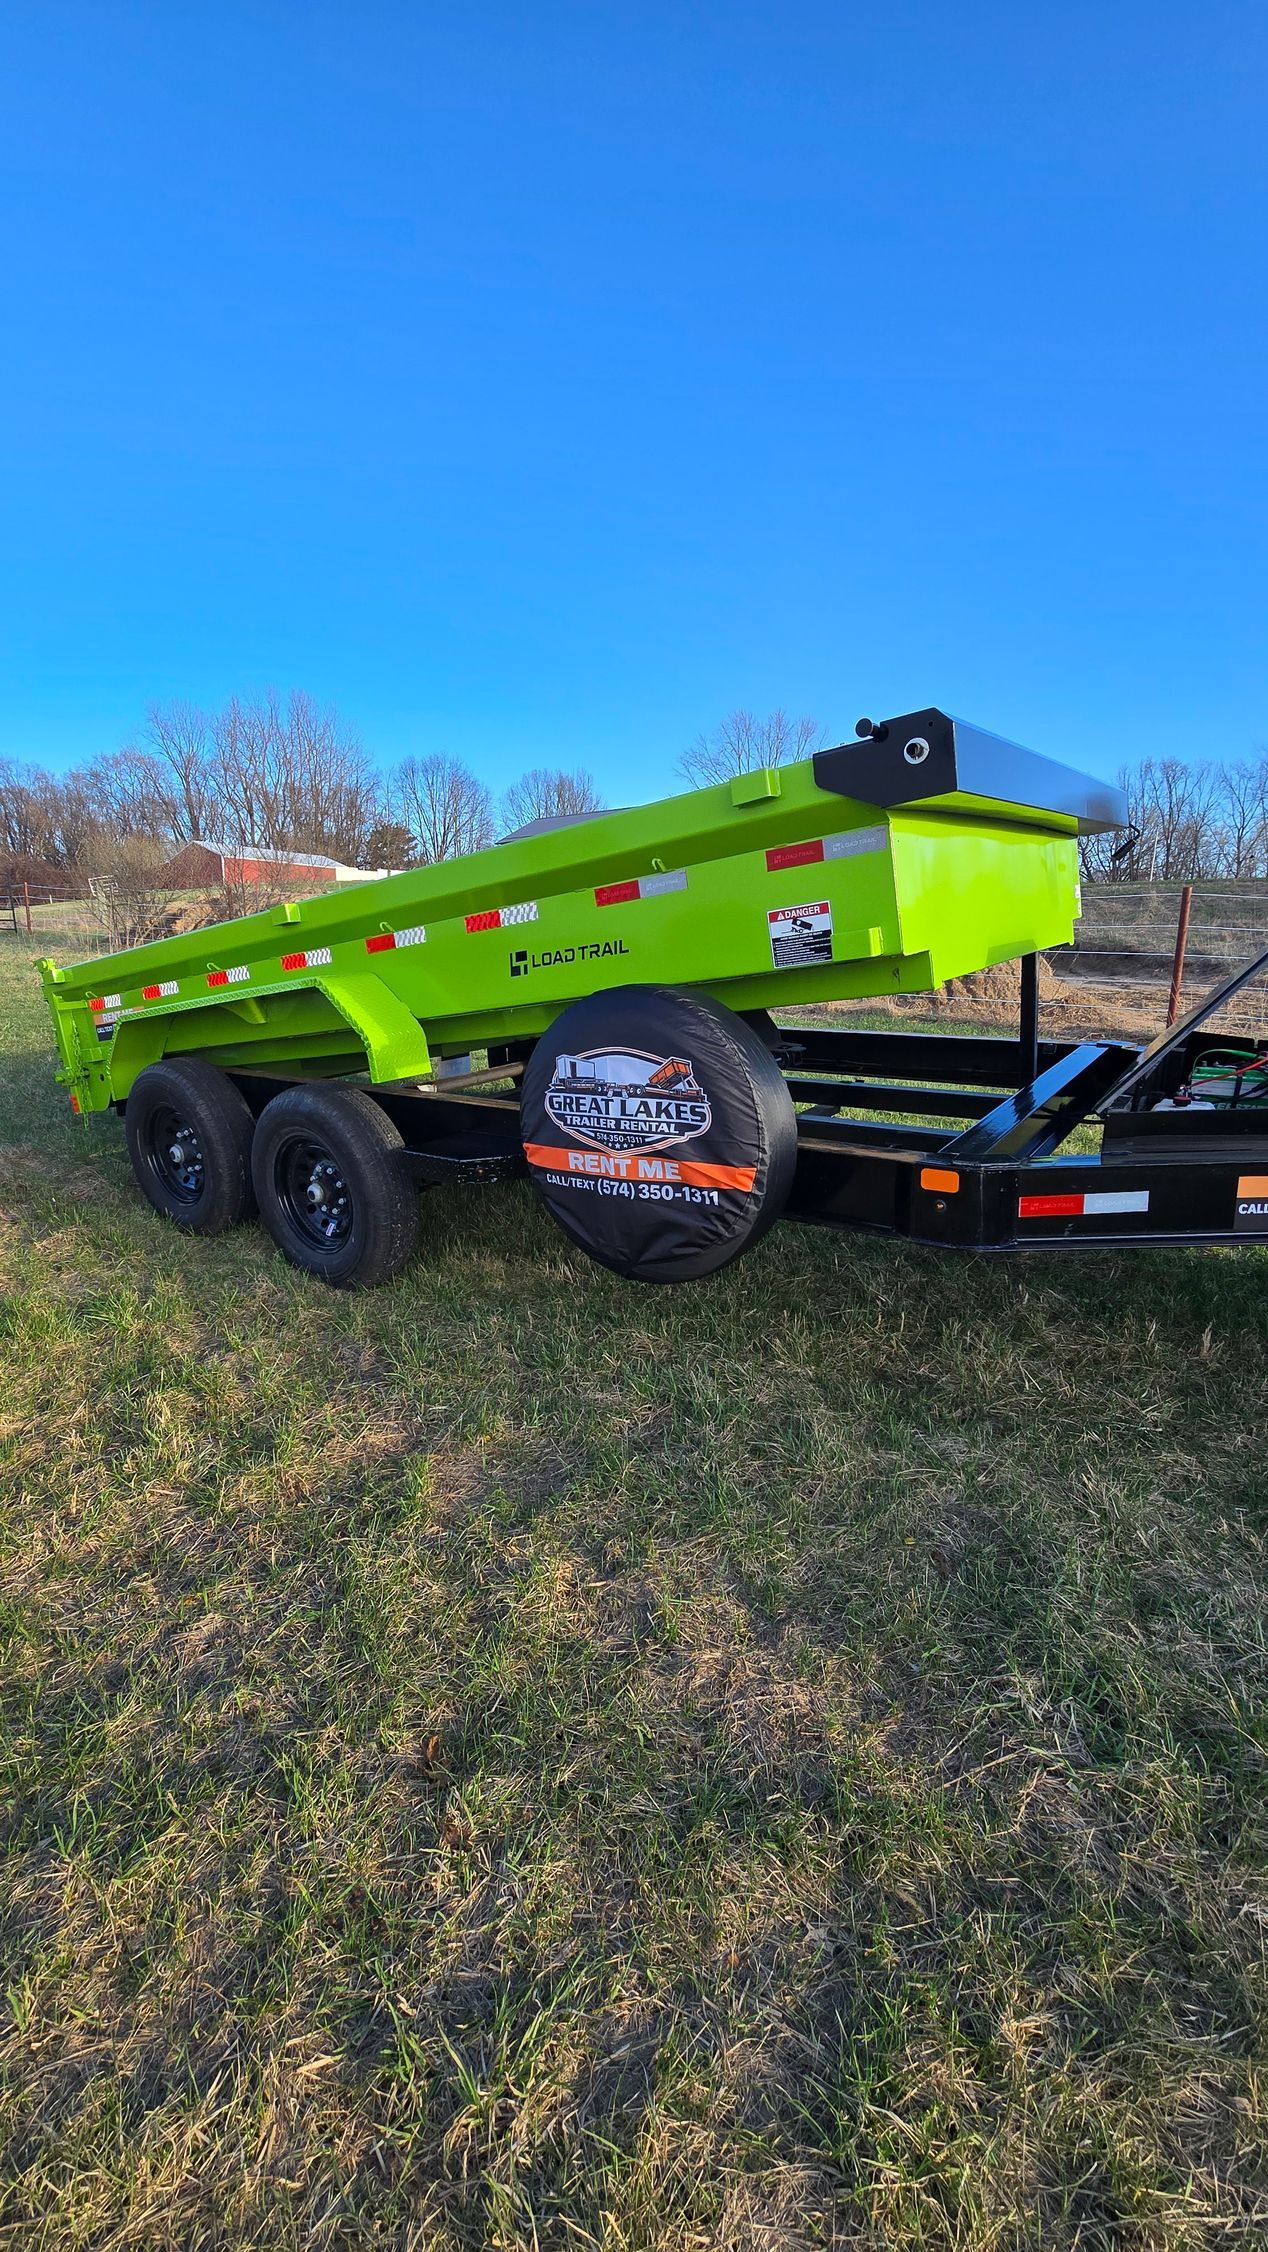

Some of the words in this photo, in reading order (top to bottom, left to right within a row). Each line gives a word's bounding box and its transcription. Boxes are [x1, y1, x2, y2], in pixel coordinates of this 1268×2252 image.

[785, 906, 820, 918] DANGER
[532, 948, 575, 968] LOAD
[578, 940, 629, 960] TRAIL
[549, 1094, 614, 1116] GREAT
[620, 1099, 706, 1122] LAKES
[565, 1115, 616, 1129] TRAILER
[620, 1119, 679, 1134] RENTAL
[597, 1132, 643, 1144] 574-350-1311
[568, 1152, 631, 1177] RENT
[638, 1159, 682, 1180] ME
[546, 1173, 595, 1191] CALL/TEXT
[597, 1178, 635, 1200] (574)
[638, 1184, 719, 1206] 350-1311
